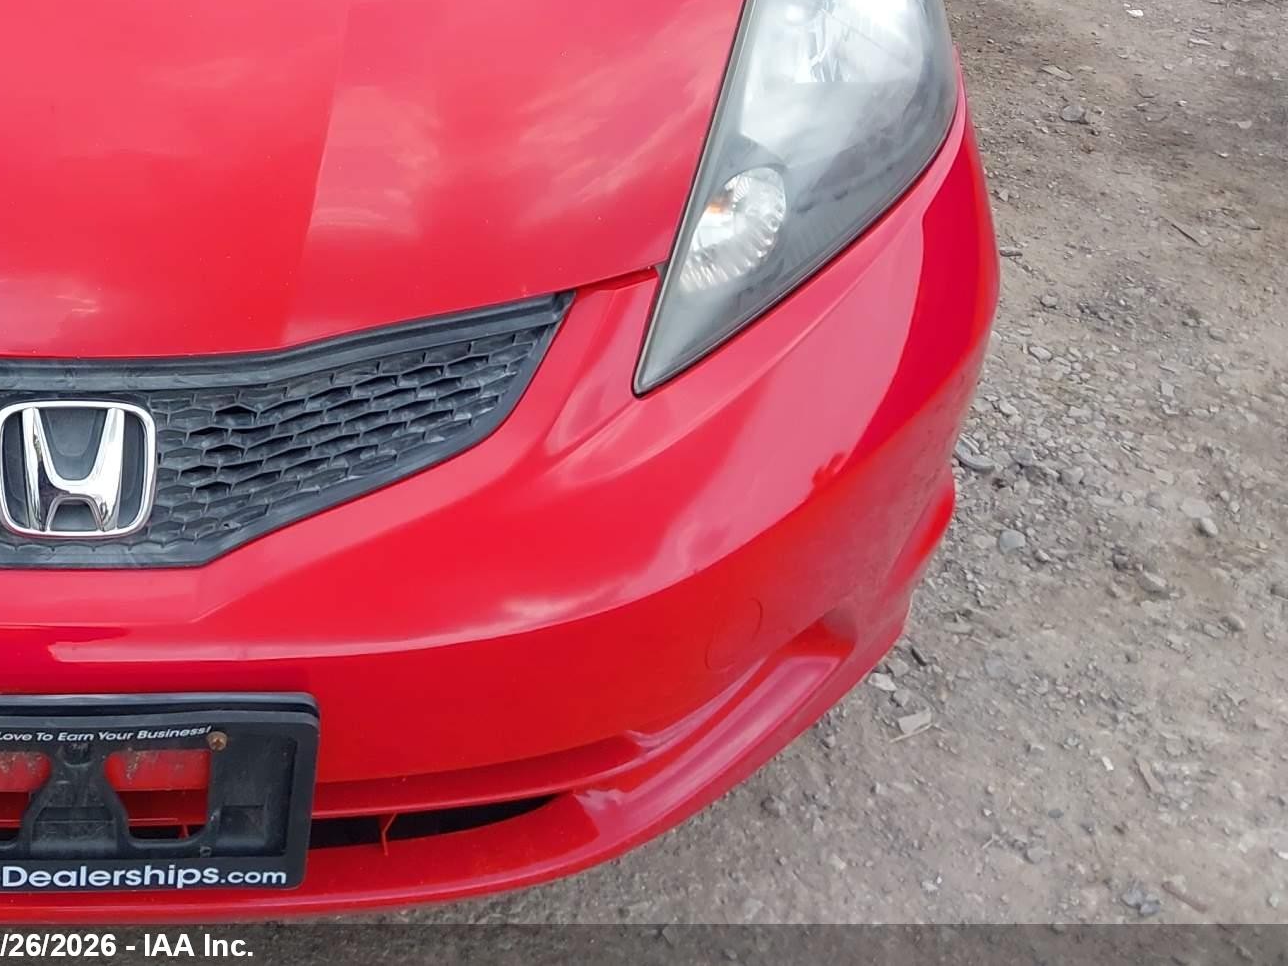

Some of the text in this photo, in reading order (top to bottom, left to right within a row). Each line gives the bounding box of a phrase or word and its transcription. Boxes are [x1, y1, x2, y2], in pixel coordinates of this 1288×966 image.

[36, 732, 53, 741] To
[57, 732, 94, 742] Earn
[98, 731, 134, 741] Your
[137, 725, 212, 740] Business!
